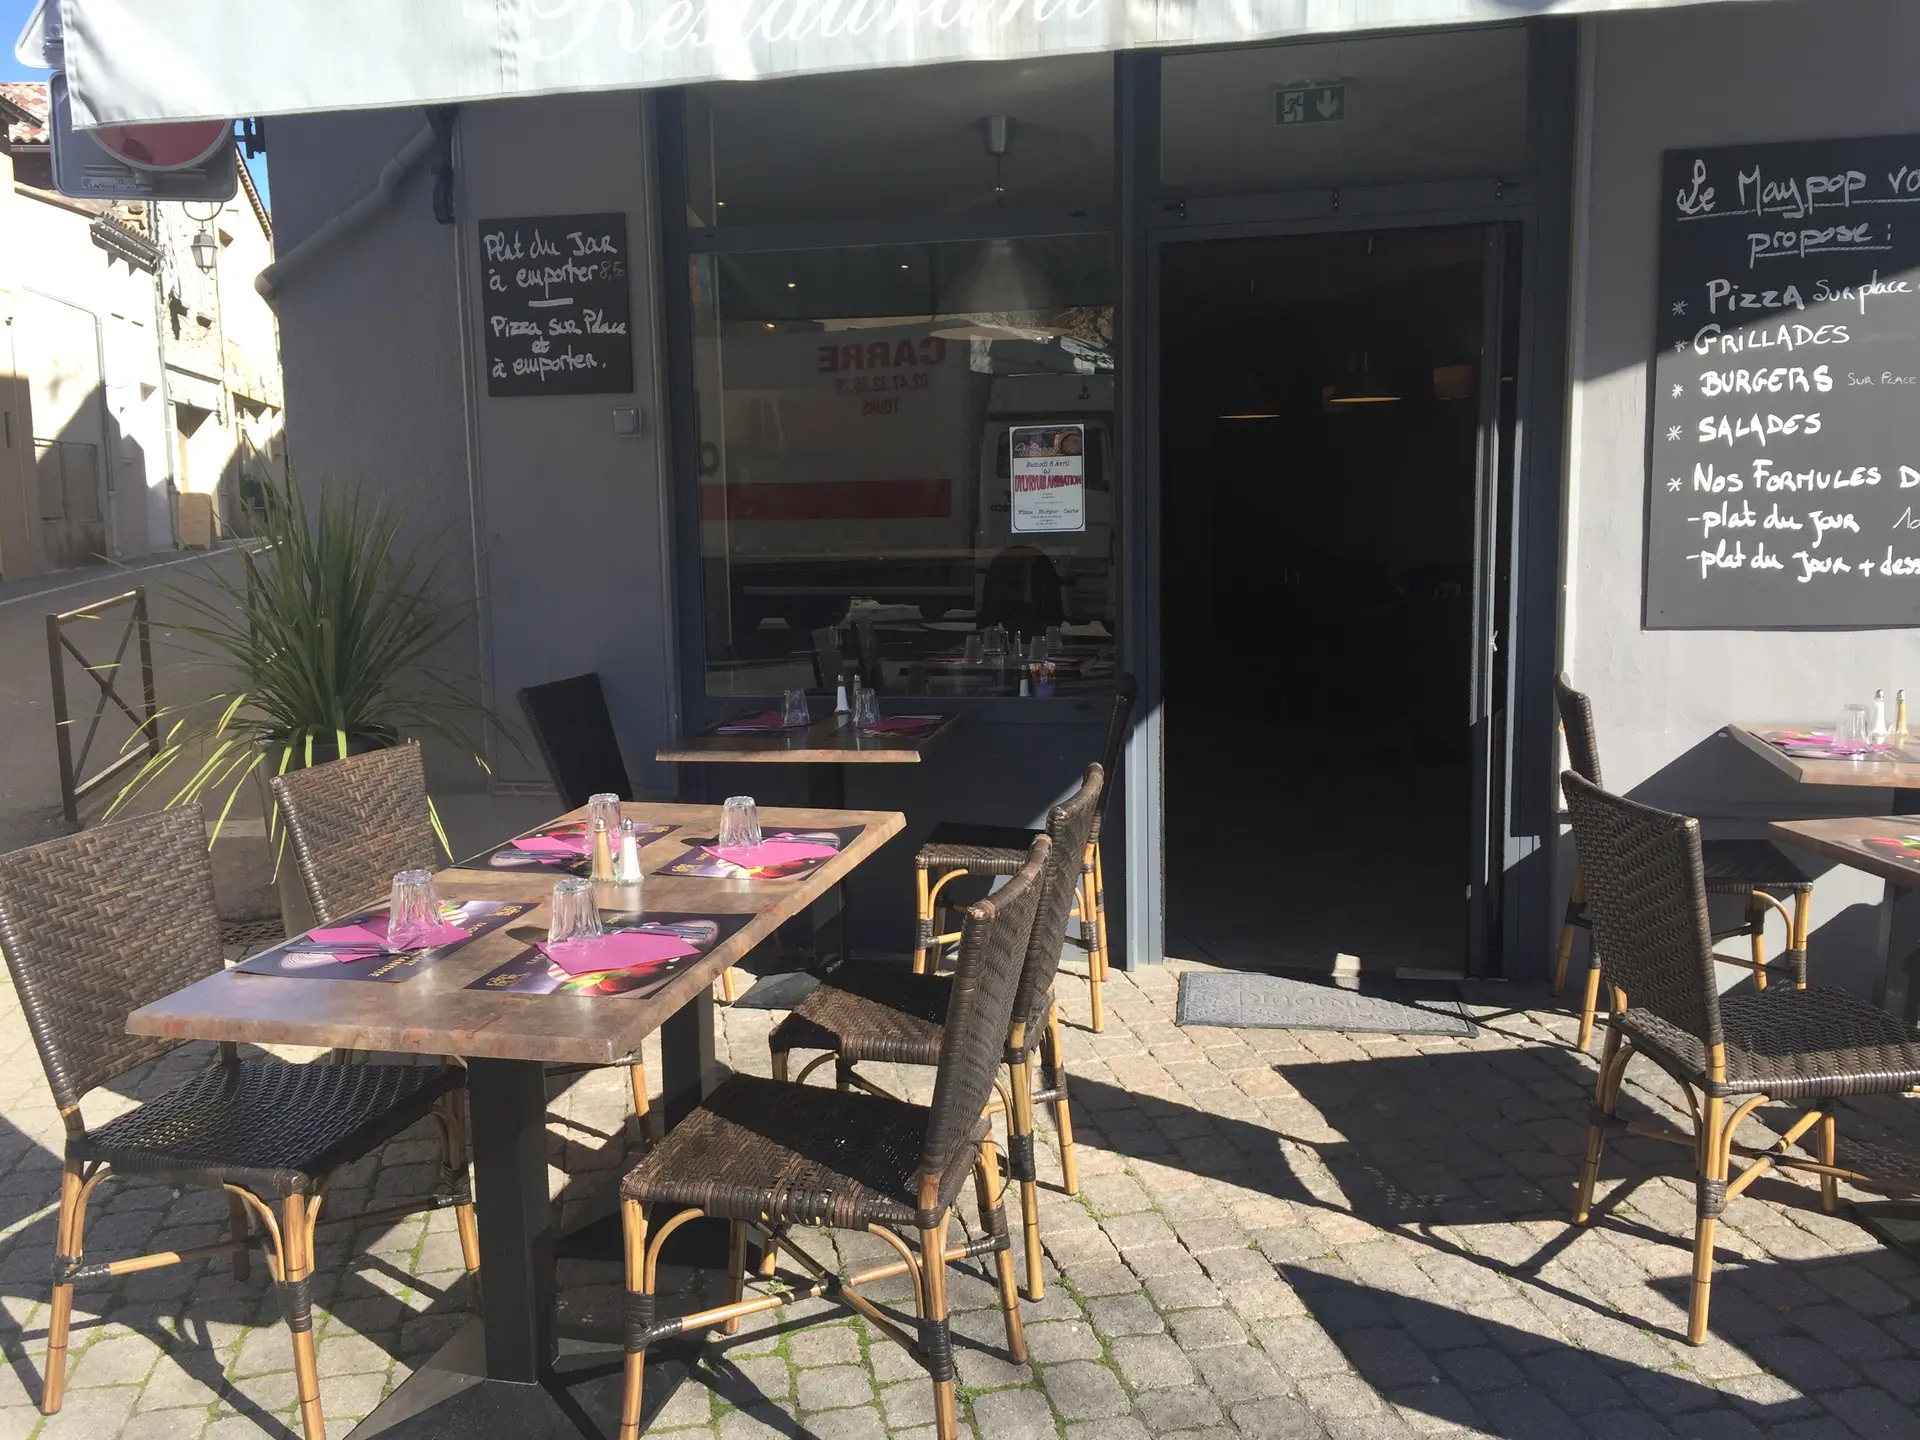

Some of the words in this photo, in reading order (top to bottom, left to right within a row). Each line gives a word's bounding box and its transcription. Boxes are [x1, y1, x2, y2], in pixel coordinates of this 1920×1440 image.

[526, 0, 1098, 61] Resauran
[1677, 159, 1716, 214] Le
[1738, 165, 1867, 218] Maypop
[483, 230, 525, 262] Plat
[529, 229, 561, 259] du
[488, 269, 508, 291] à
[516, 257, 598, 299] emporter
[491, 315, 543, 337] Pizza
[1693, 322, 1851, 356] GRILLADES
[531, 336, 550, 354] et
[492, 358, 508, 378] à
[1699, 365, 1834, 397] BURGERS
[1698, 412, 1822, 447] SALADES
[1763, 503, 1803, 529] du
[1750, 542, 1785, 570] du
